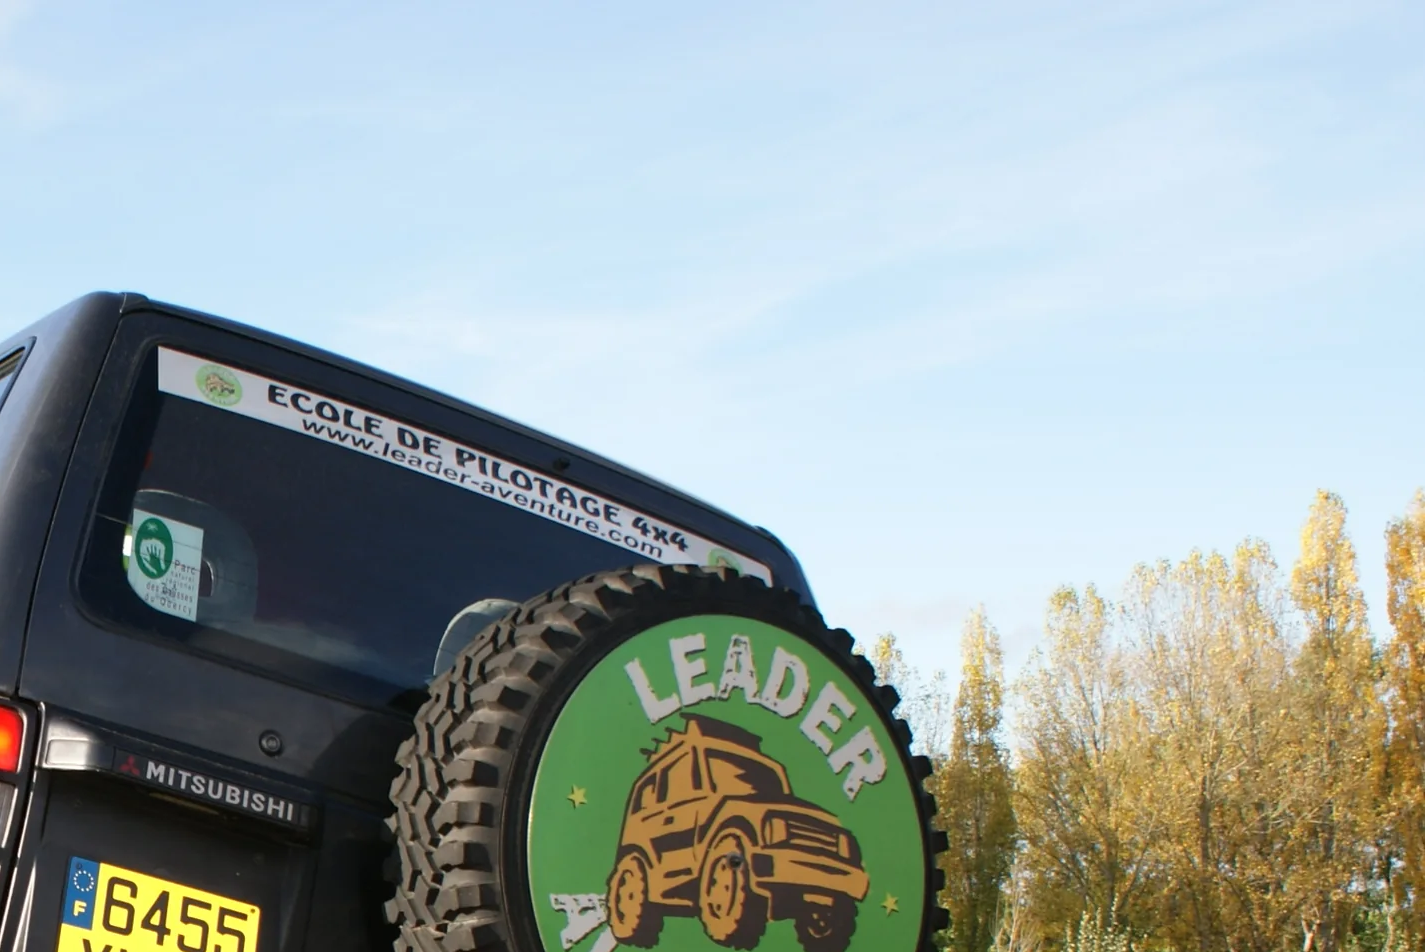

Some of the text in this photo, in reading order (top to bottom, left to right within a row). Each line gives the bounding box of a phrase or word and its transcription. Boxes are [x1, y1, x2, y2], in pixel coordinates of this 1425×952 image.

[268, 384, 383, 439] ECOLE
[397, 427, 442, 460] DE
[455, 447, 621, 527] PILOTAGE
[631, 516, 688, 552] 4x4
[302, 419, 662, 559] www.leader-aventure.com
[174, 559, 196, 575] Parc
[624, 632, 888, 800] LEADER
[146, 760, 294, 821] MITSUBISHI
[73, 900, 87, 916] F
